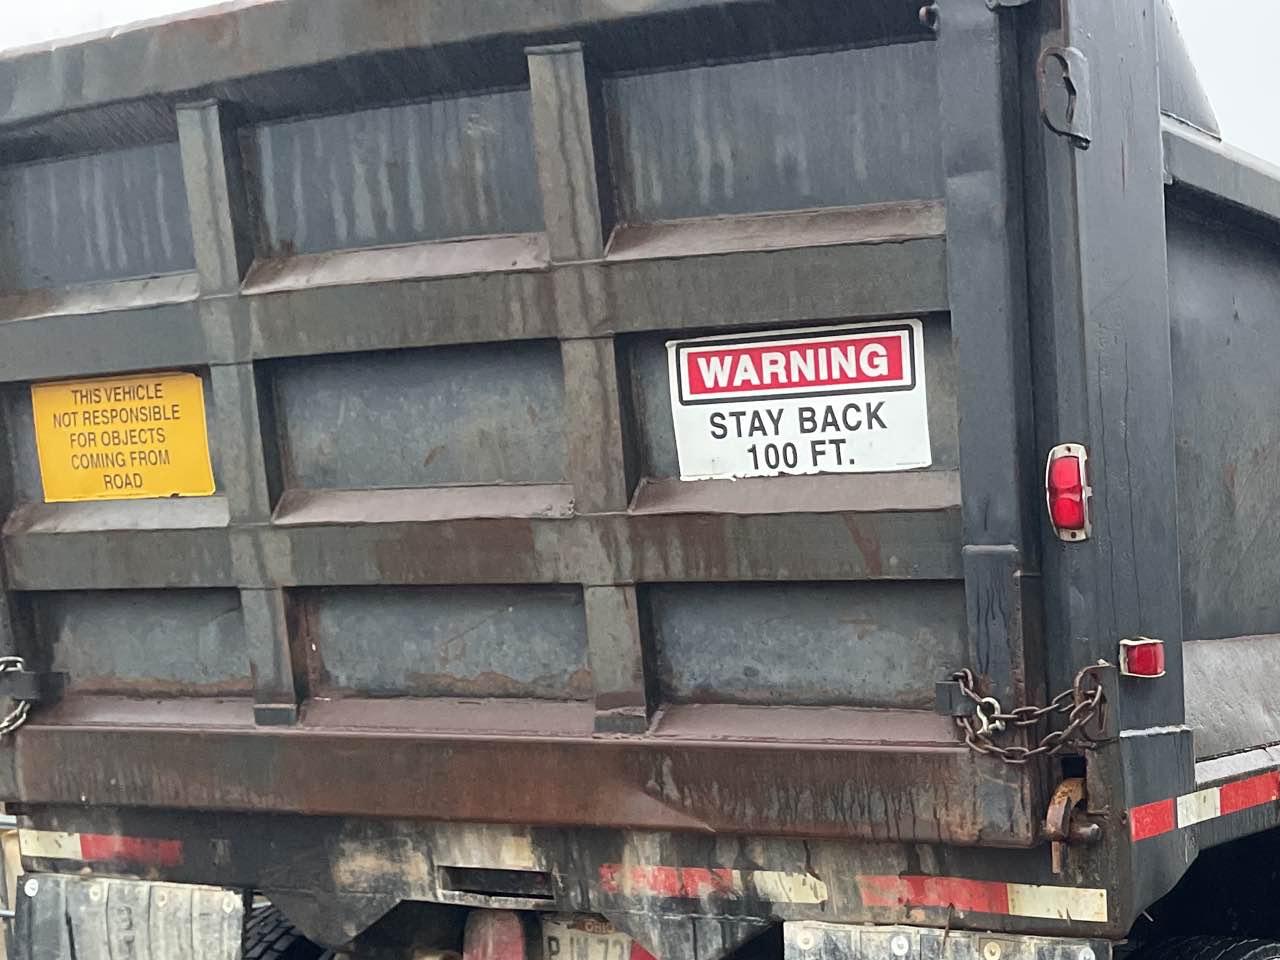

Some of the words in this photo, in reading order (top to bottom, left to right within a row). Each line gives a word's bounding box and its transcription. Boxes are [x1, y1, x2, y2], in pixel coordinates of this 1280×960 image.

[697, 343, 888, 388] WARNING
[71, 388, 102, 406] THIS
[104, 383, 163, 402] VEHICLE
[53, 411, 79, 428] NOT
[83, 404, 181, 427] RESPONSIBLE
[710, 408, 785, 440] STAY
[798, 401, 888, 434] BACK
[70, 432, 97, 449] FOR
[101, 427, 166, 447] OBJECTS
[71, 452, 126, 470] COMING
[130, 449, 171, 466] FROM
[747, 441, 799, 470] 100
[810, 438, 856, 467] FT.
[103, 473, 143, 490] ROAD
